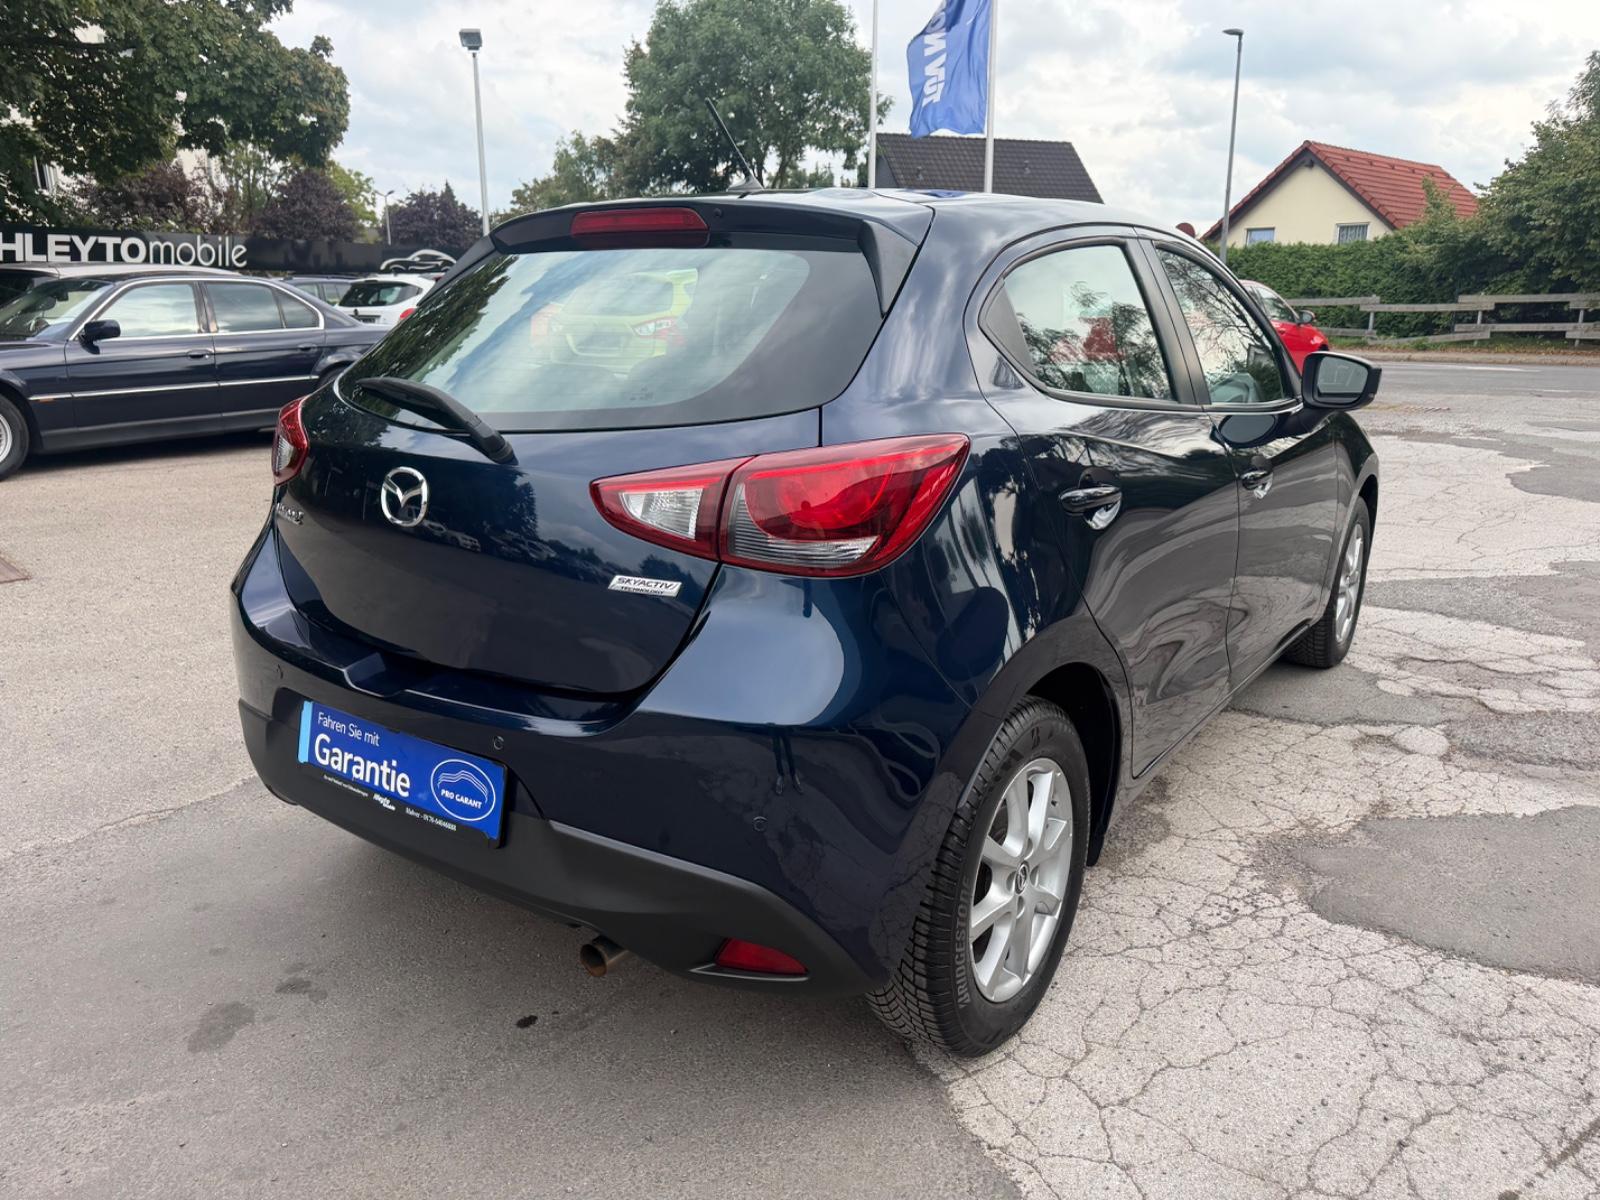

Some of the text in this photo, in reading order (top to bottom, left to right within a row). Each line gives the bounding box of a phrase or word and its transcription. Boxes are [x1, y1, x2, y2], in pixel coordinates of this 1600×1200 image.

[0, 231, 248, 268] HLEYTOmobile
[616, 576, 675, 590] SKYACTIV
[317, 711, 381, 747] Fahren Sie mit
[314, 733, 411, 798] Garantie
[440, 788, 483, 809] PRO GARANT
